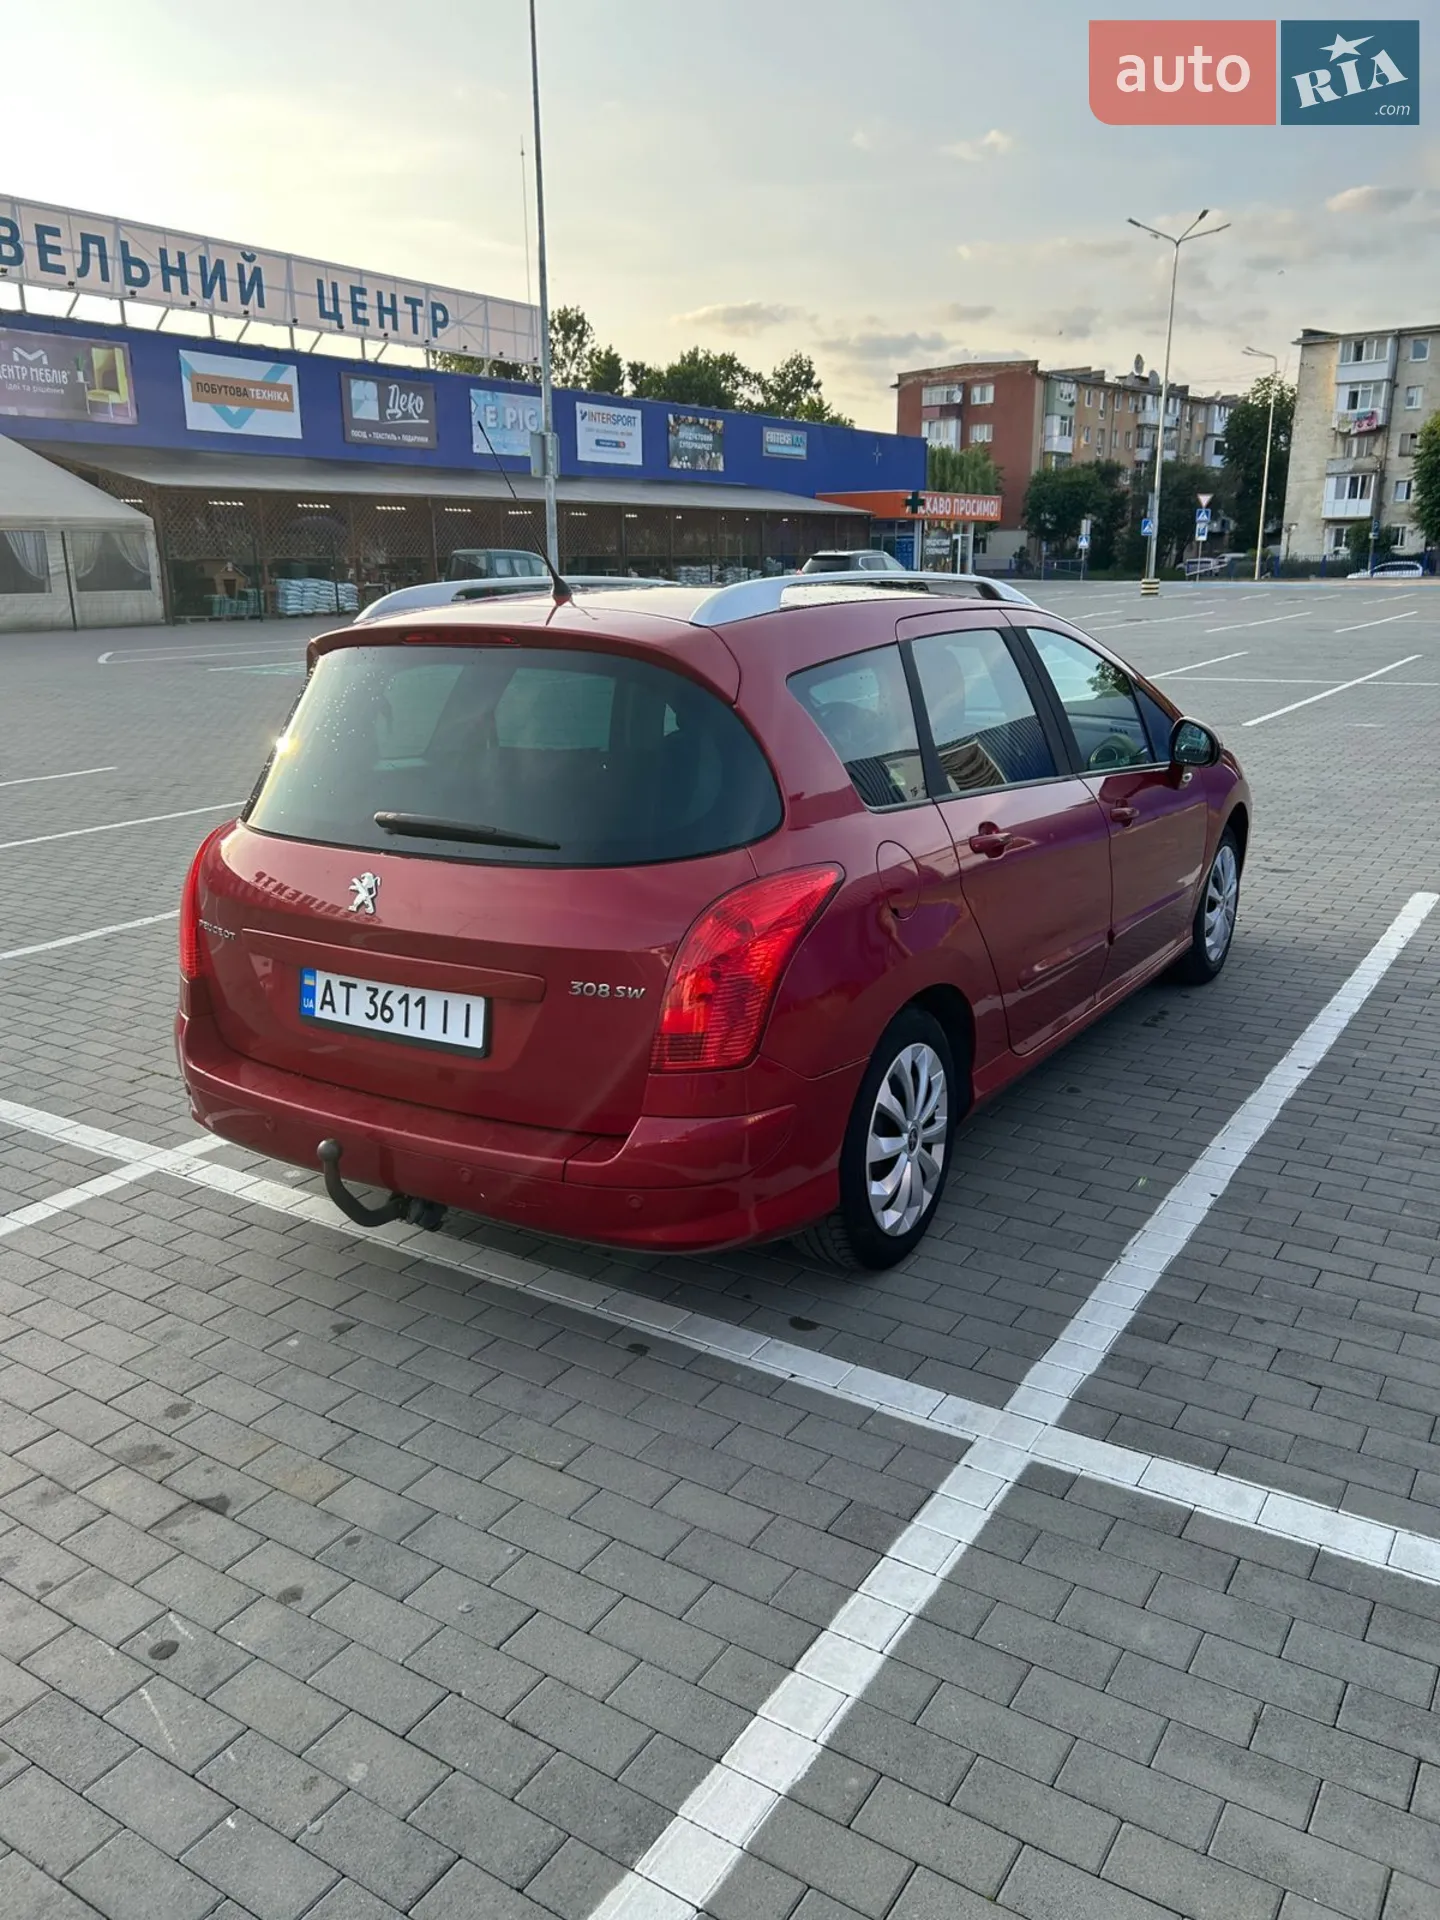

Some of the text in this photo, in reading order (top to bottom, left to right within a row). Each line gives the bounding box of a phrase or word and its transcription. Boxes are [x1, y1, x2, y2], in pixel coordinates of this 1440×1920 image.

[0, 216, 449, 338] ВЕЛЬНИЙ ЦЕНТР
[0, 364, 68, 385] ЕНТР МЕБЛІВ
[196, 382, 289, 403] ПОБУТОВА ТЕХНІКА
[385, 384, 424, 420] Деко
[588, 410, 638, 427] INTERSPORT
[953, 498, 998, 517] ПРОСИМО!
[568, 981, 610, 998] 308
[303, 997, 314, 1009] UA
[319, 979, 357, 1016] AT
[364, 986, 427, 1030] 3611
